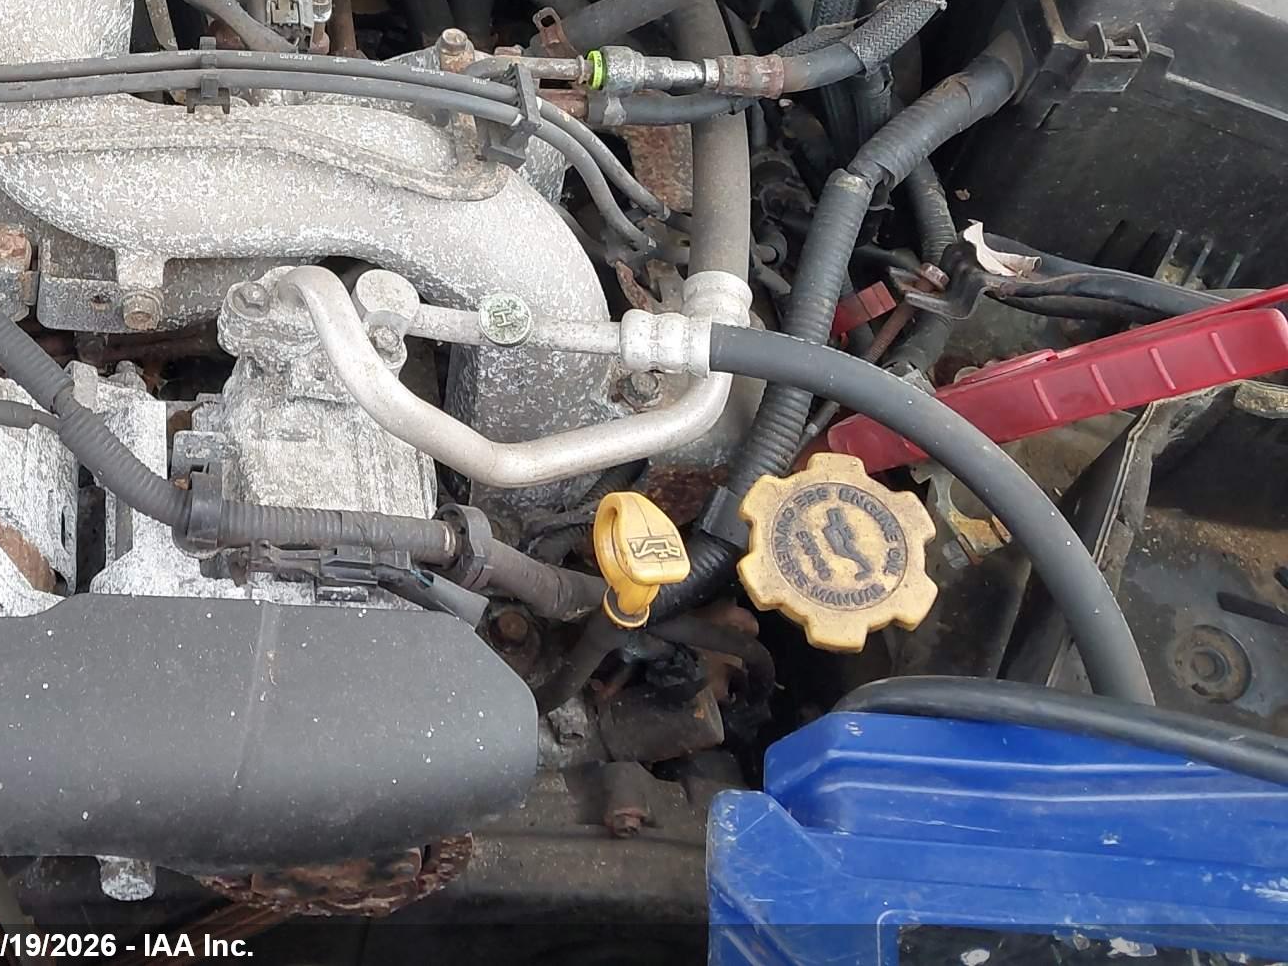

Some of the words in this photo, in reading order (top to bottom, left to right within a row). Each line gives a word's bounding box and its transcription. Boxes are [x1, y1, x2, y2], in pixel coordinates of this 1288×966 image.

[793, 488, 828, 508] SEE
[811, 584, 886, 606] MANUAL
[838, 487, 900, 543] ENGINE
[884, 548, 902, 575] OIL
